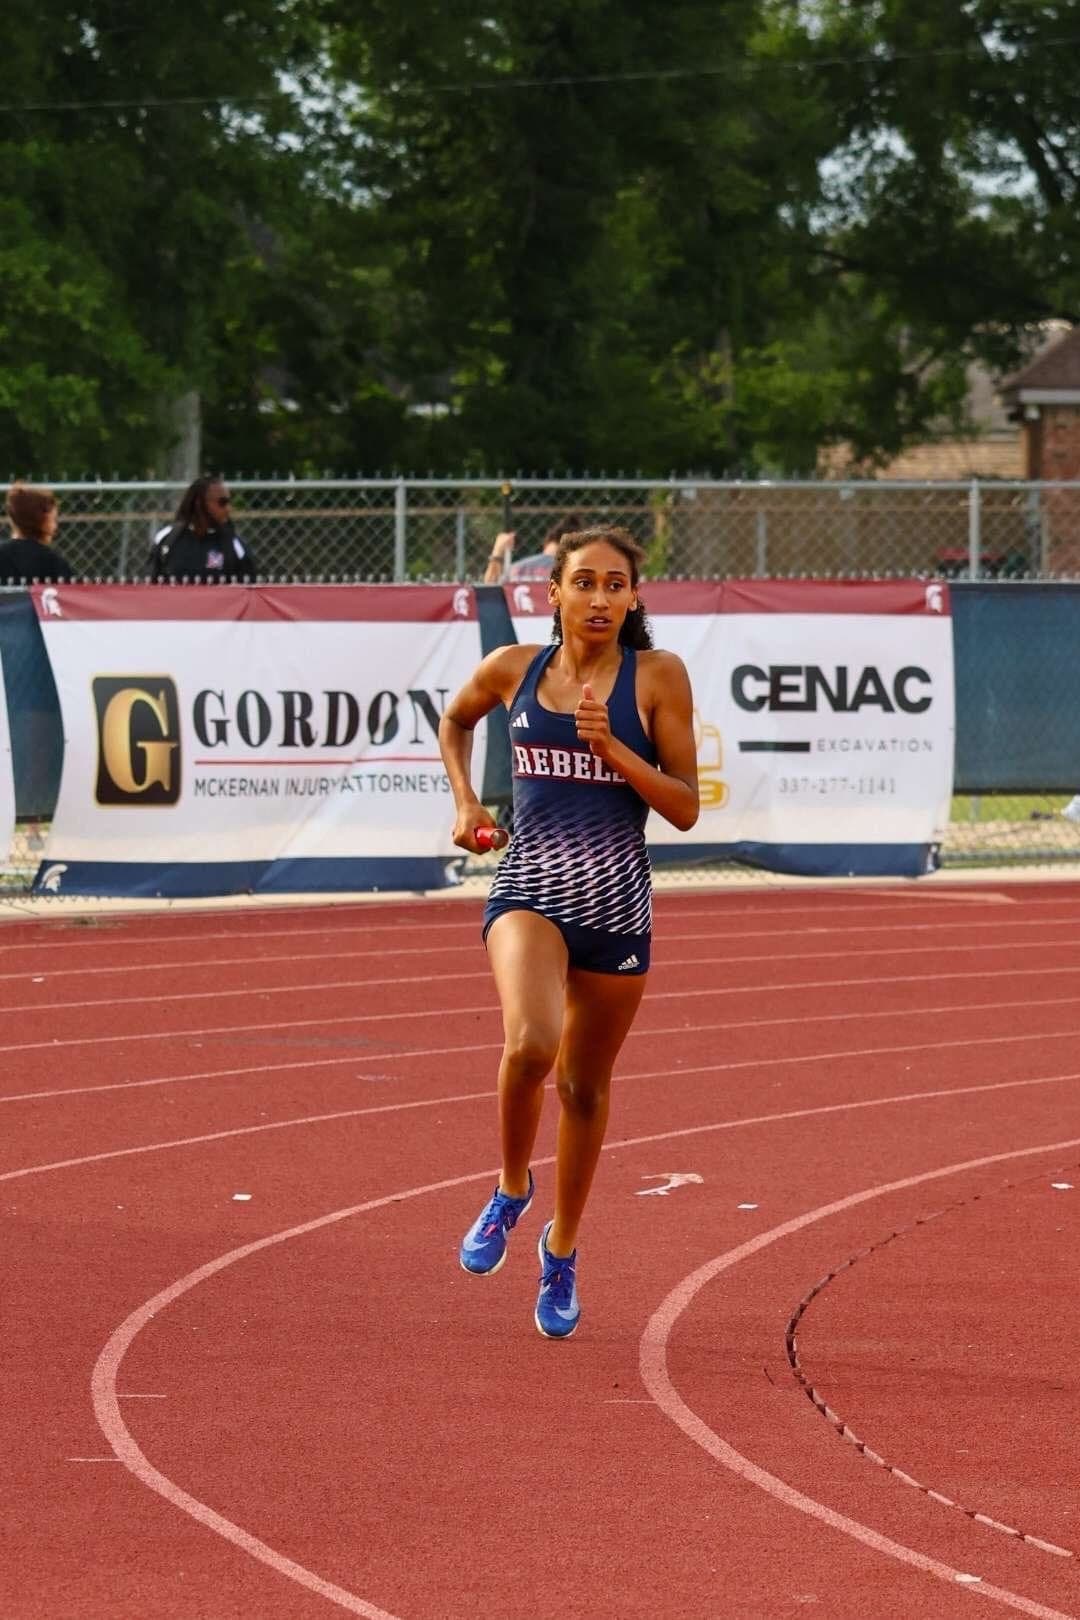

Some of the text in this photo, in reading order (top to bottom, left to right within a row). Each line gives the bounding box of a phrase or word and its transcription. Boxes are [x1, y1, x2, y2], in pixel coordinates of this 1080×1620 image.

[731, 664, 933, 714] CENAC
[193, 689, 449, 748] GORDON
[103, 688, 178, 793] G
[817, 739, 933, 752] EXCAVATION
[515, 746, 626, 782] REBEL
[194, 778, 279, 796] MCKERNAN
[779, 777, 895, 795] 337-277-1141
